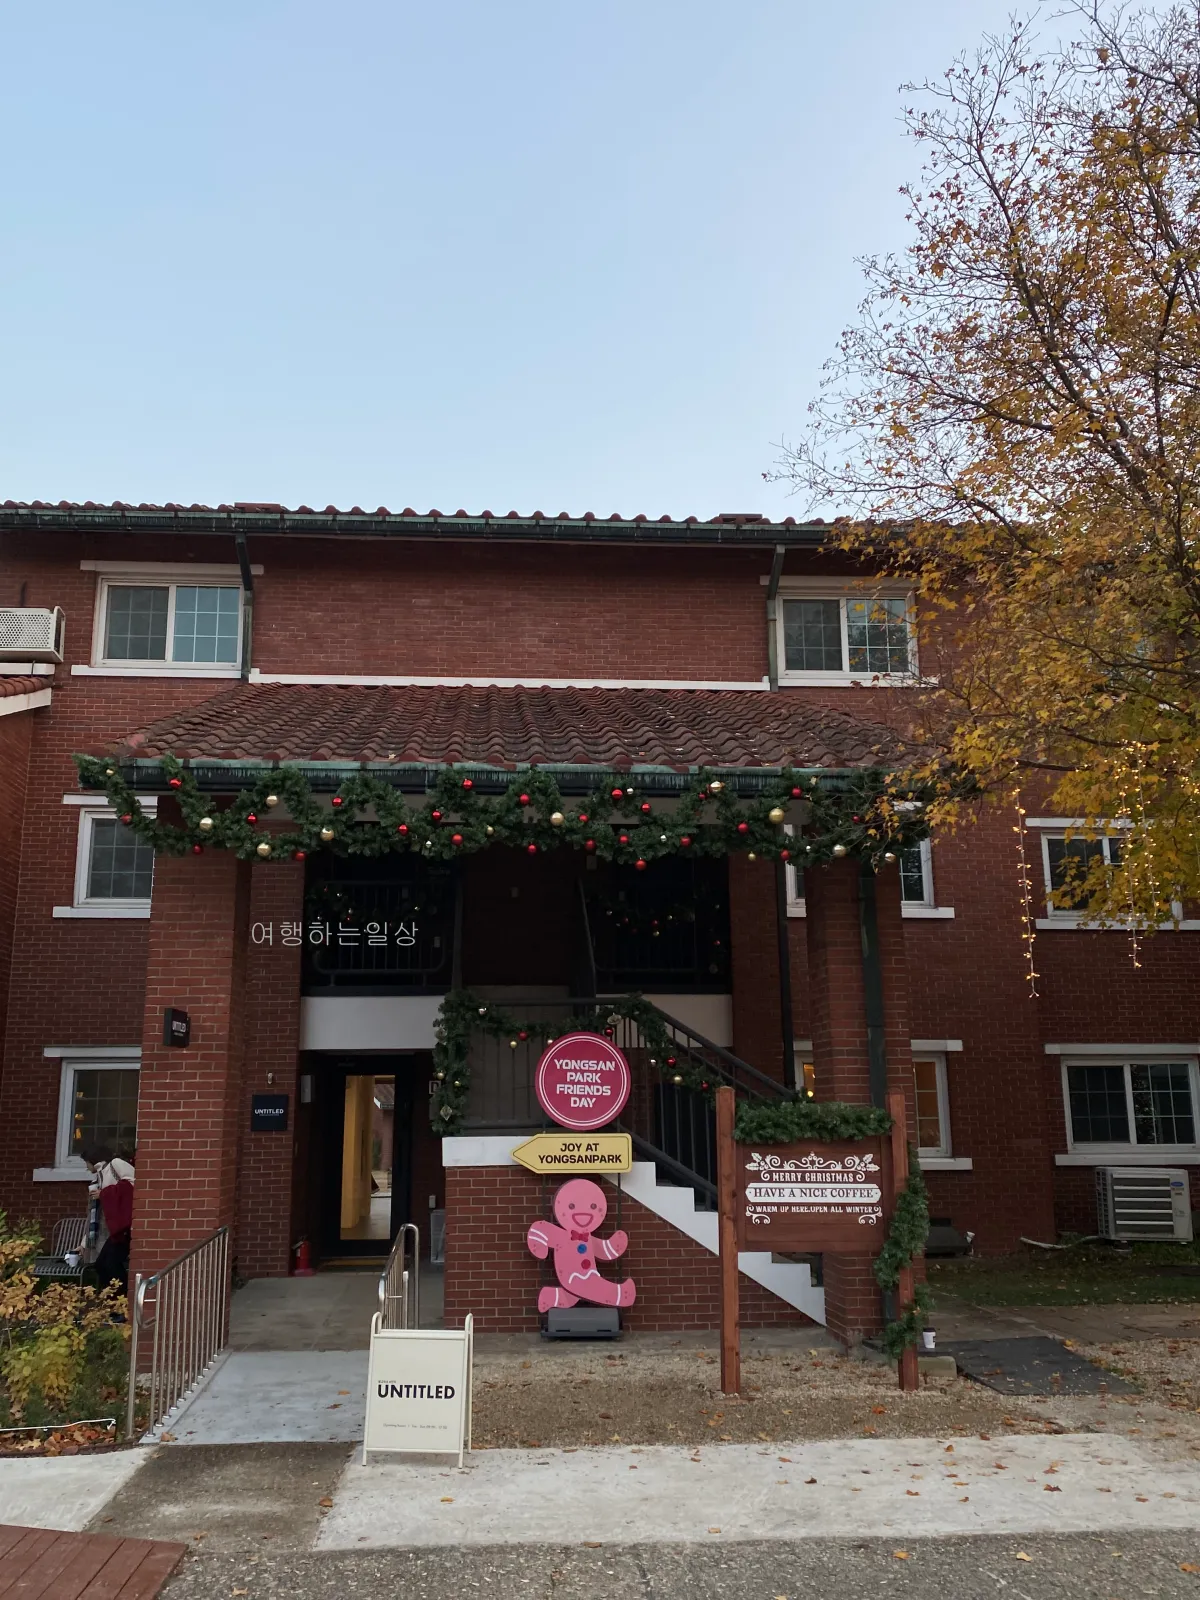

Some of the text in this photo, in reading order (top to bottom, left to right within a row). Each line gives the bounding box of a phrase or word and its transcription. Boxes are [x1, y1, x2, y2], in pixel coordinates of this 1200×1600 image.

[554, 1059, 615, 1071] YONGSAN
[566, 1072, 601, 1083] PARK
[556, 1084, 611, 1096] FRIENDS
[570, 1097, 596, 1108] DAY
[560, 1143, 599, 1152] JOY AT
[538, 1154, 622, 1164] YONGSANPARK
[772, 1172, 854, 1182] MERRY CHRISTMAS
[753, 1188, 874, 1198] HAVE A NICE COFFEE
[377, 1384, 455, 1399] UNTITLED
